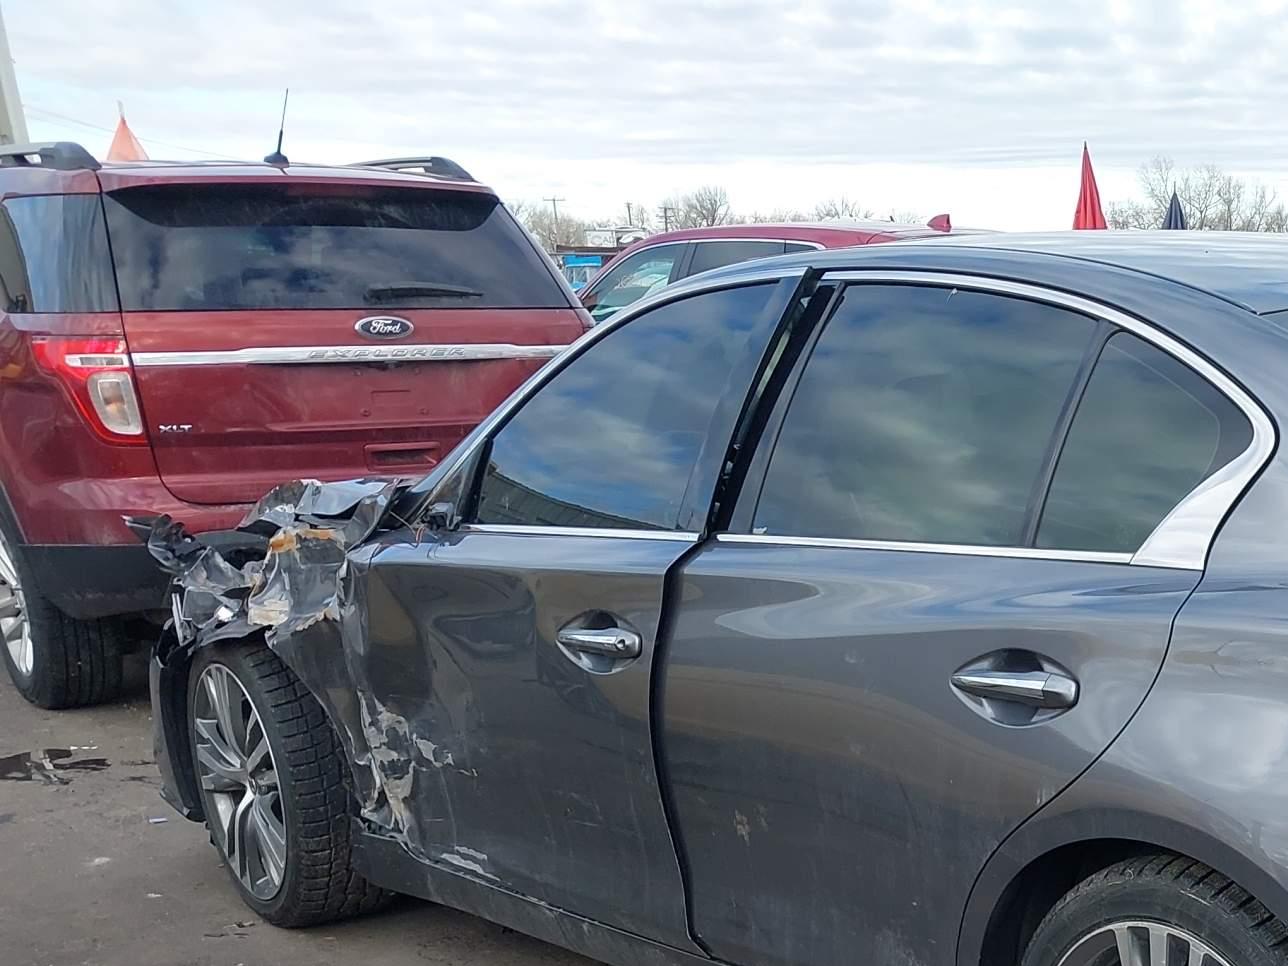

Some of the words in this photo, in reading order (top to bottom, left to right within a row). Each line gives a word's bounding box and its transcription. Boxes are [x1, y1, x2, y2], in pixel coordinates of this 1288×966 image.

[370, 319, 401, 334] Ford
[310, 348, 465, 359] EXPLORER
[158, 424, 193, 433] XLT
